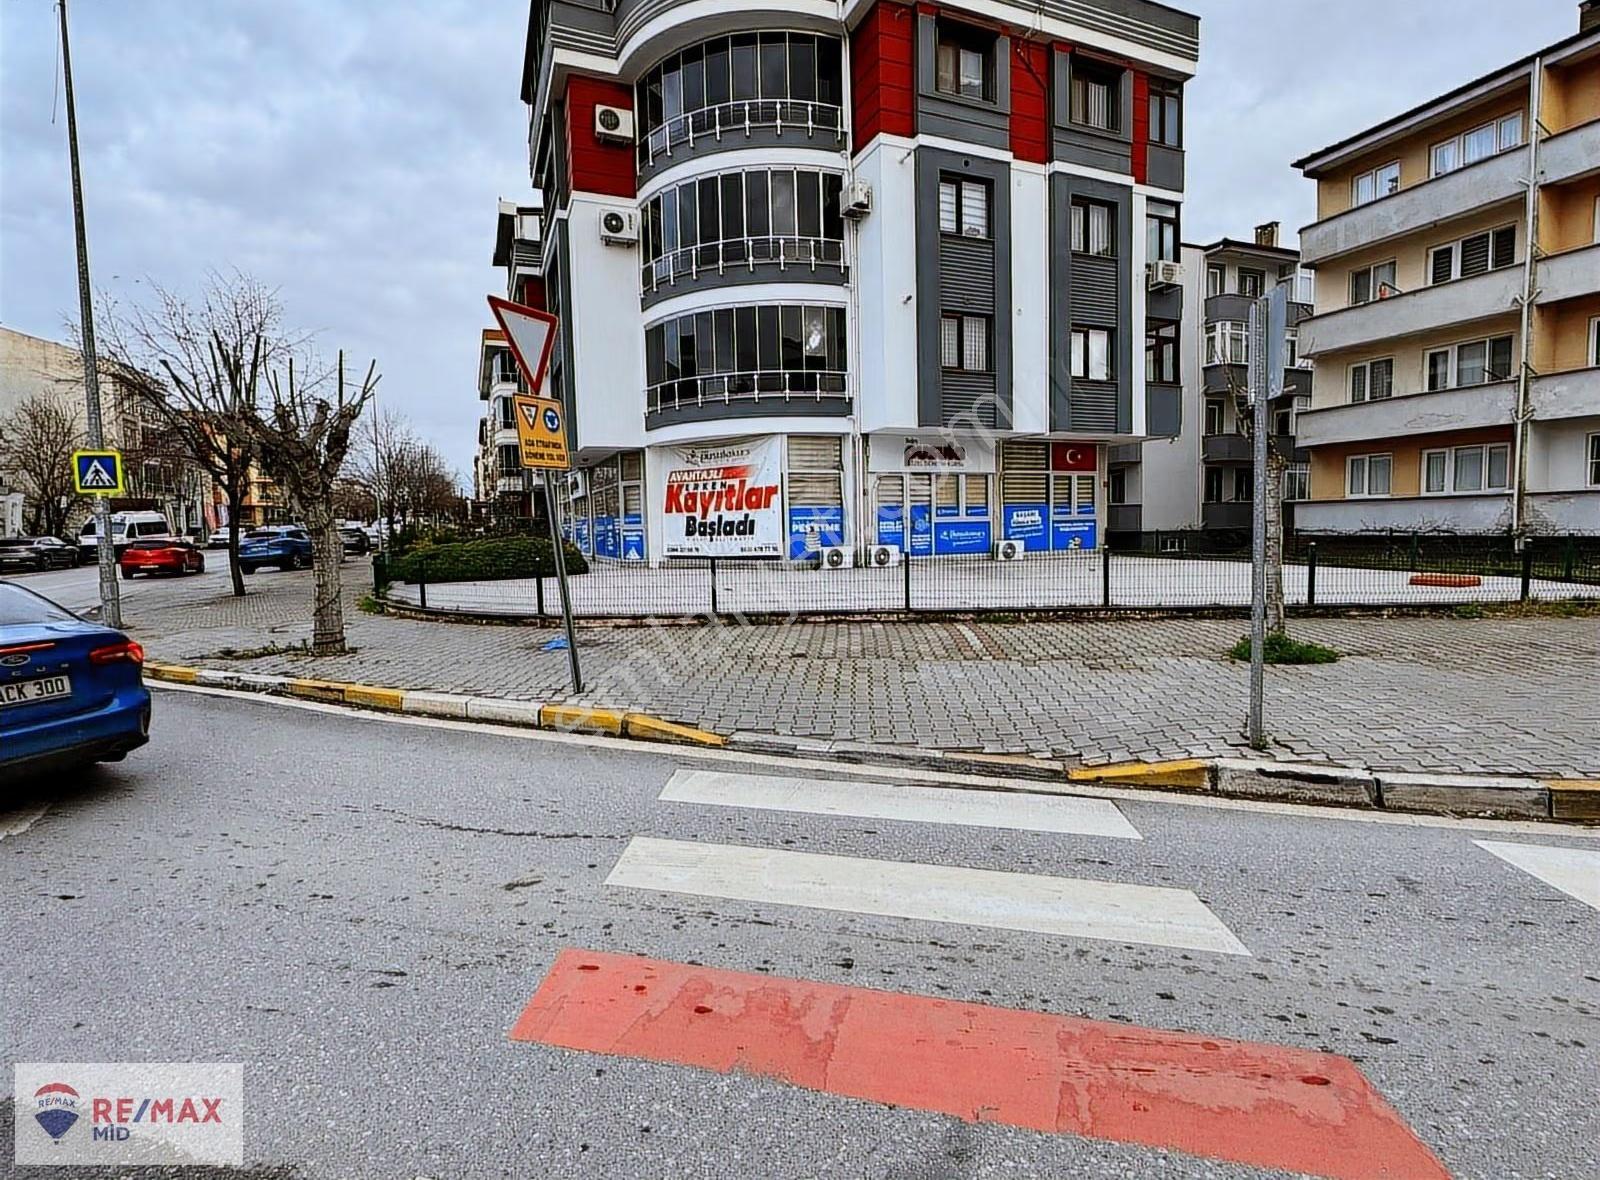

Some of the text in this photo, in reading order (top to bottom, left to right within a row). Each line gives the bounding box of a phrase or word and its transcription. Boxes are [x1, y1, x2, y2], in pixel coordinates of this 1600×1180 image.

[669, 469, 724, 483] AVANTAJLI
[684, 481, 728, 492] ERKEN
[664, 479, 779, 520] Kayıtlar
[685, 513, 755, 542] Başladı
[33, 678, 65, 697] 300
